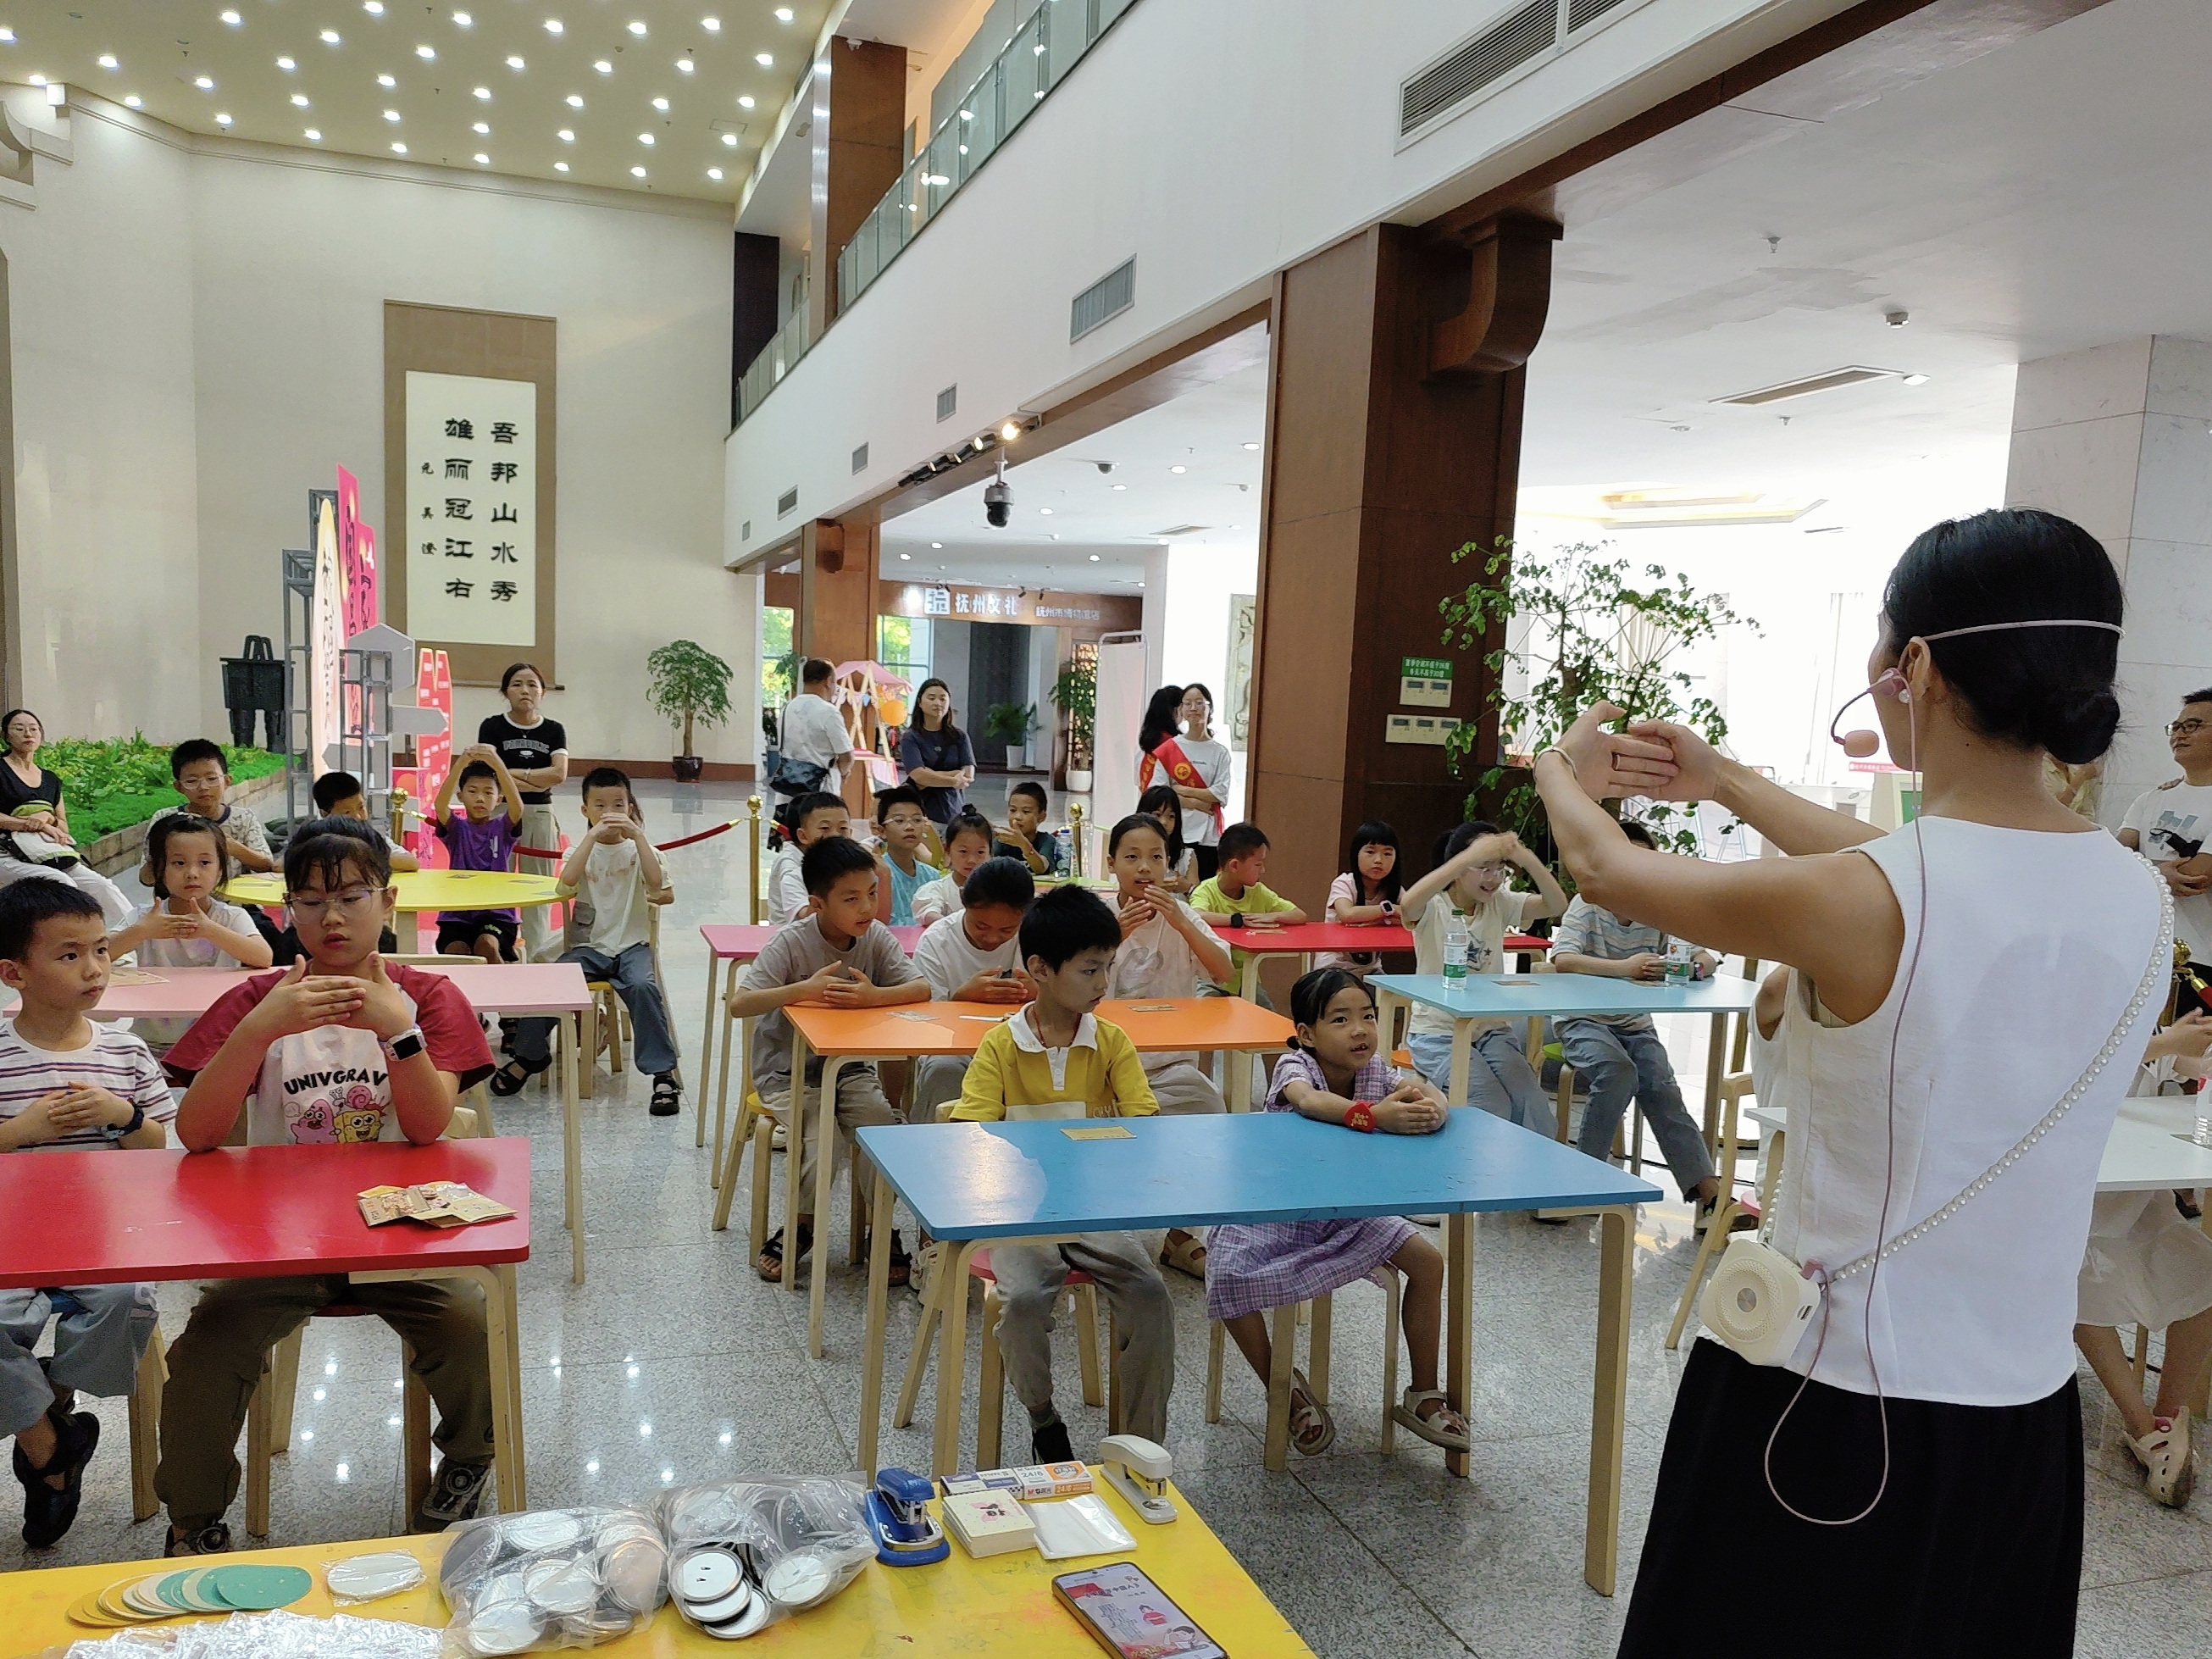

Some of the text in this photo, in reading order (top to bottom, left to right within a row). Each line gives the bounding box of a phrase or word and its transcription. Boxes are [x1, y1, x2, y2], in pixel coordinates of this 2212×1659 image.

[491, 422, 518, 602] 吾邦山水秀
[955, 591, 1018, 616] 抚州文礼
[283, 1068, 388, 1095] UNIVGRAV
